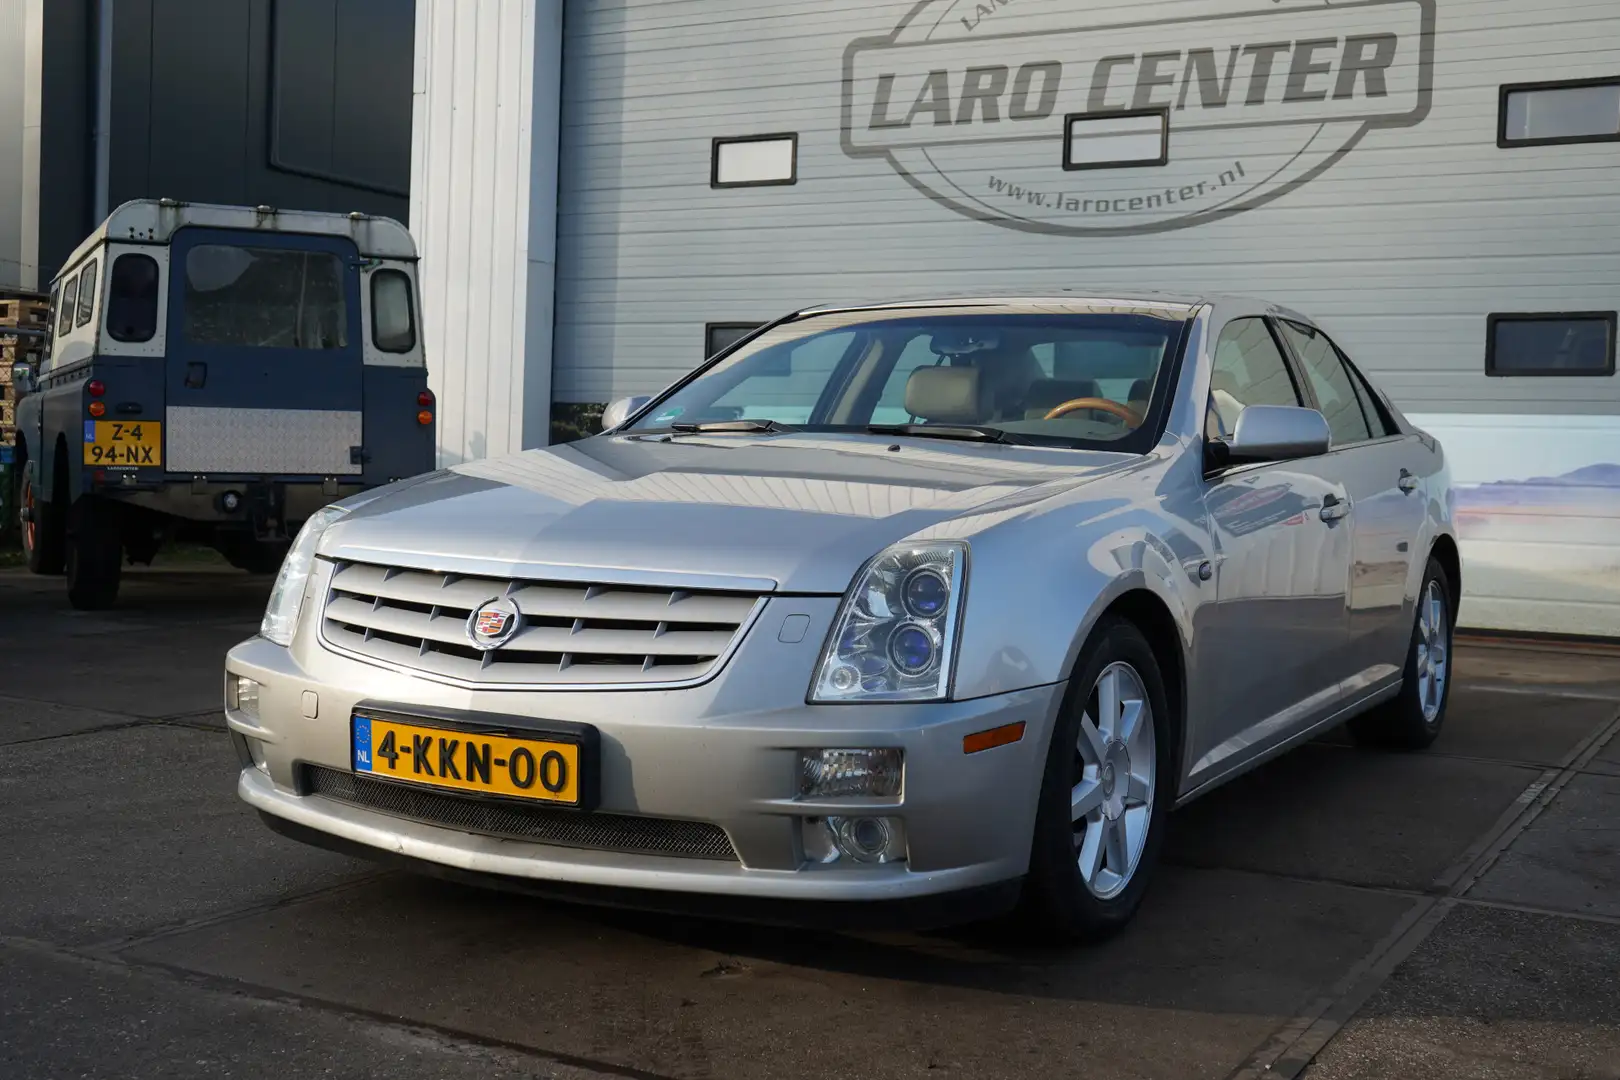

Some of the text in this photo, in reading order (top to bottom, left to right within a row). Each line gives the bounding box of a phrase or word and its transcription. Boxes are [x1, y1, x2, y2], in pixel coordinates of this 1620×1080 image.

[868, 32, 1398, 130] LARO CENTER
[987, 161, 1246, 213] www.larocenter.nl
[111, 423, 143, 441] Z-4
[91, 445, 153, 464] 94-NX
[357, 749, 370, 763] NL
[377, 730, 567, 793] 4-KKN-00
